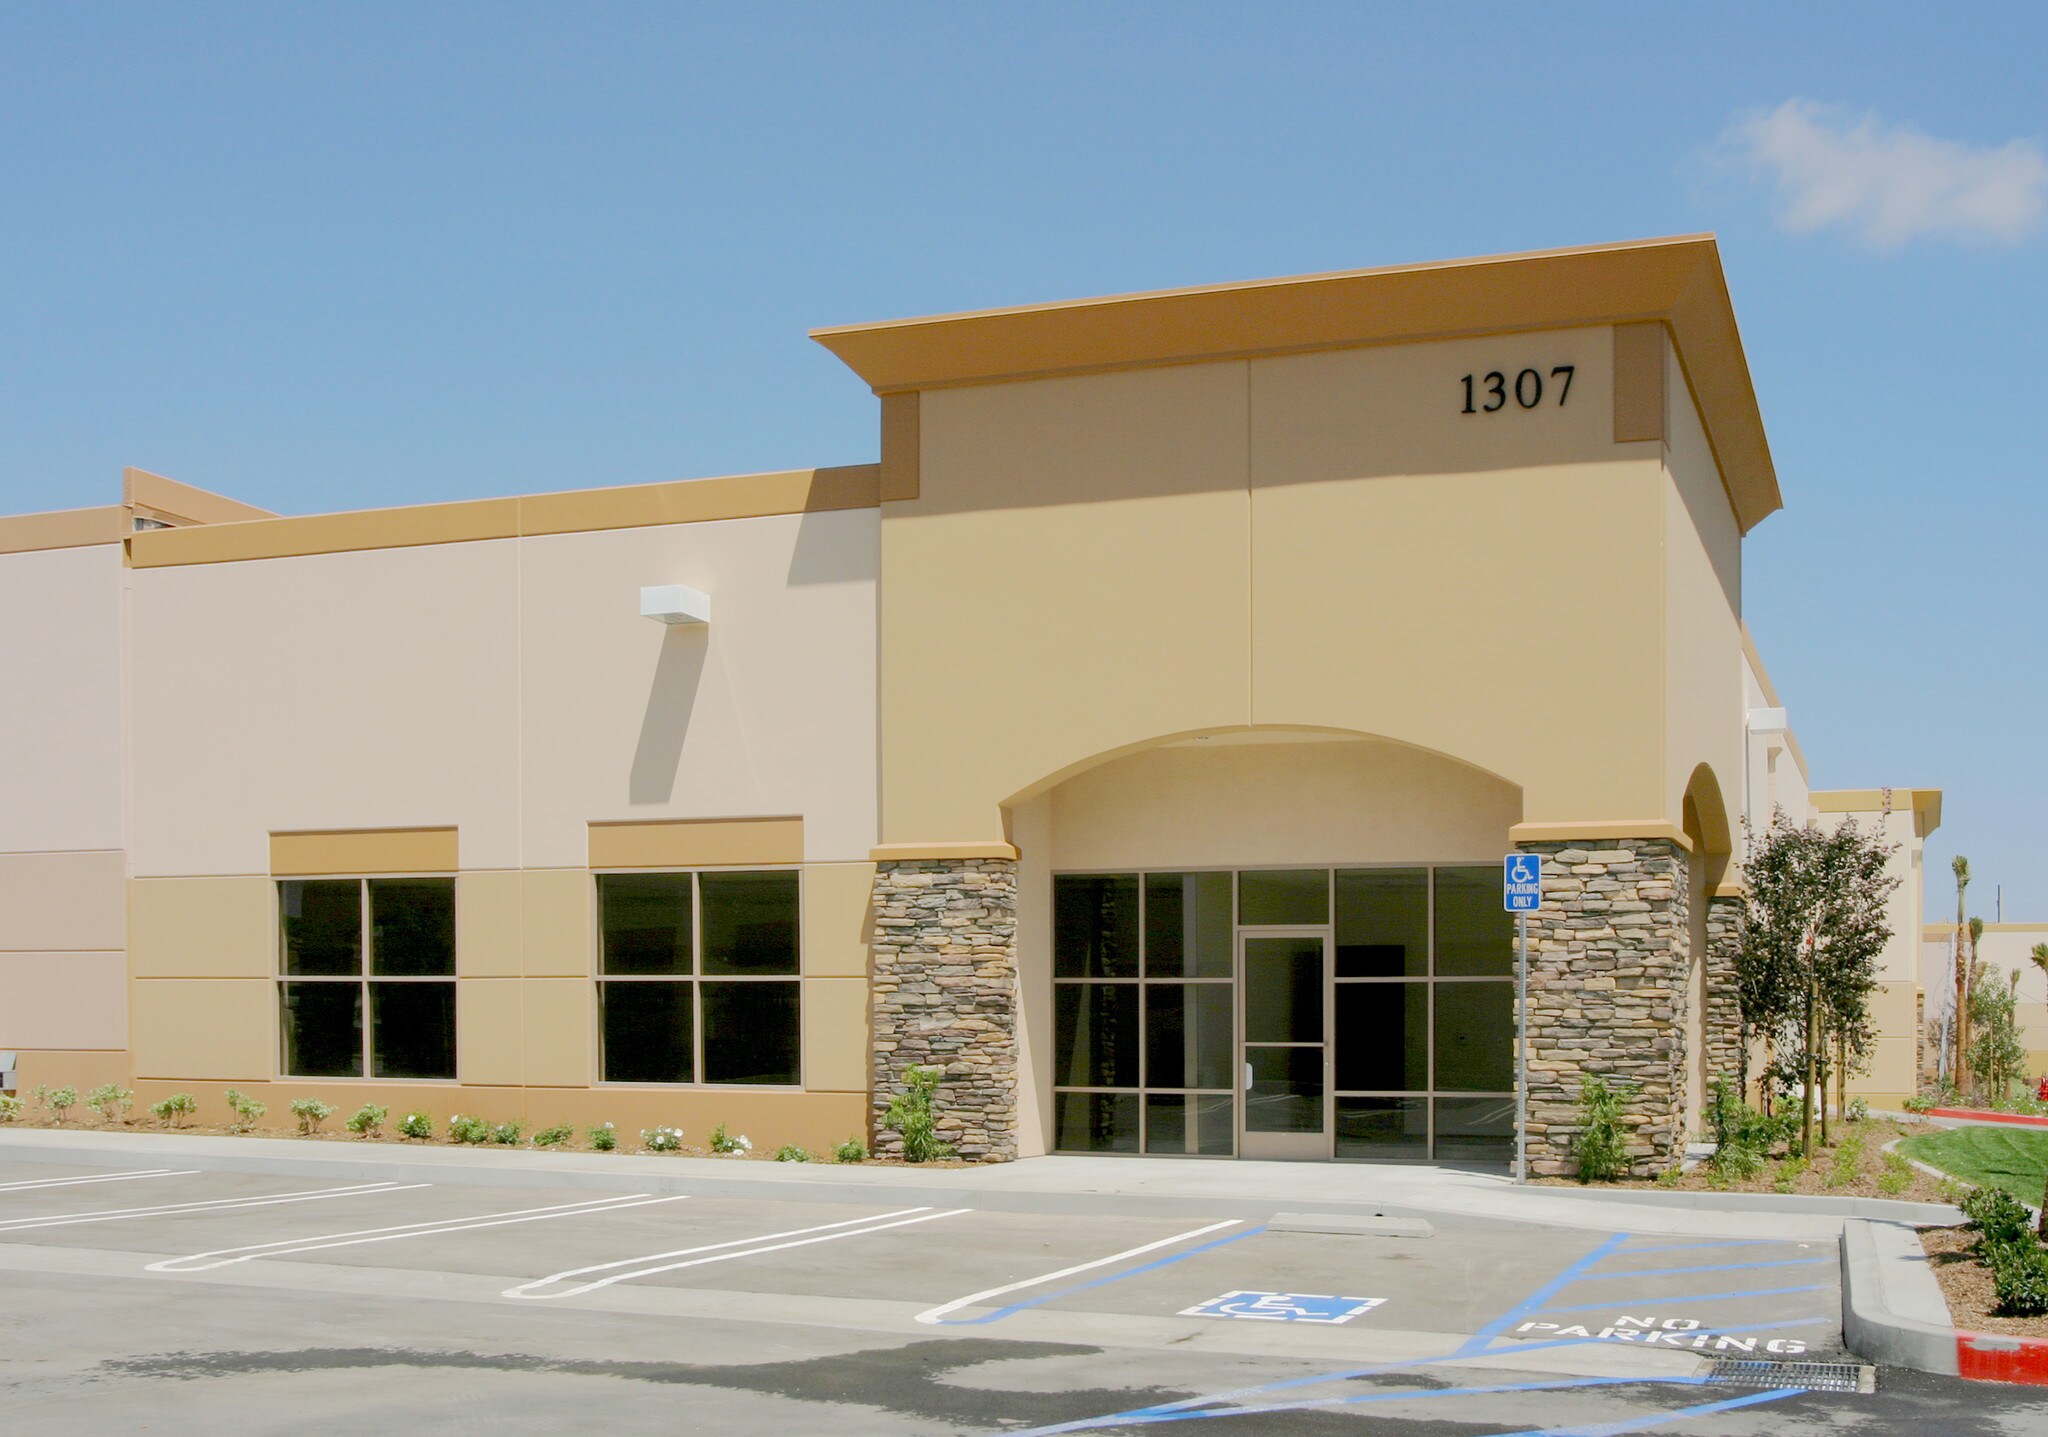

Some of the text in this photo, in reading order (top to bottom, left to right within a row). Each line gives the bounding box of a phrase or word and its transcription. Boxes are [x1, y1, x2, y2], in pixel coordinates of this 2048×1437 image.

[1461, 366, 1575, 413] 1307
[1507, 883, 1539, 894] PARKING
[1512, 896, 1532, 907] ONLY
[1615, 1315, 1700, 1330] NO
[1516, 1322, 1806, 1353] PARKING
